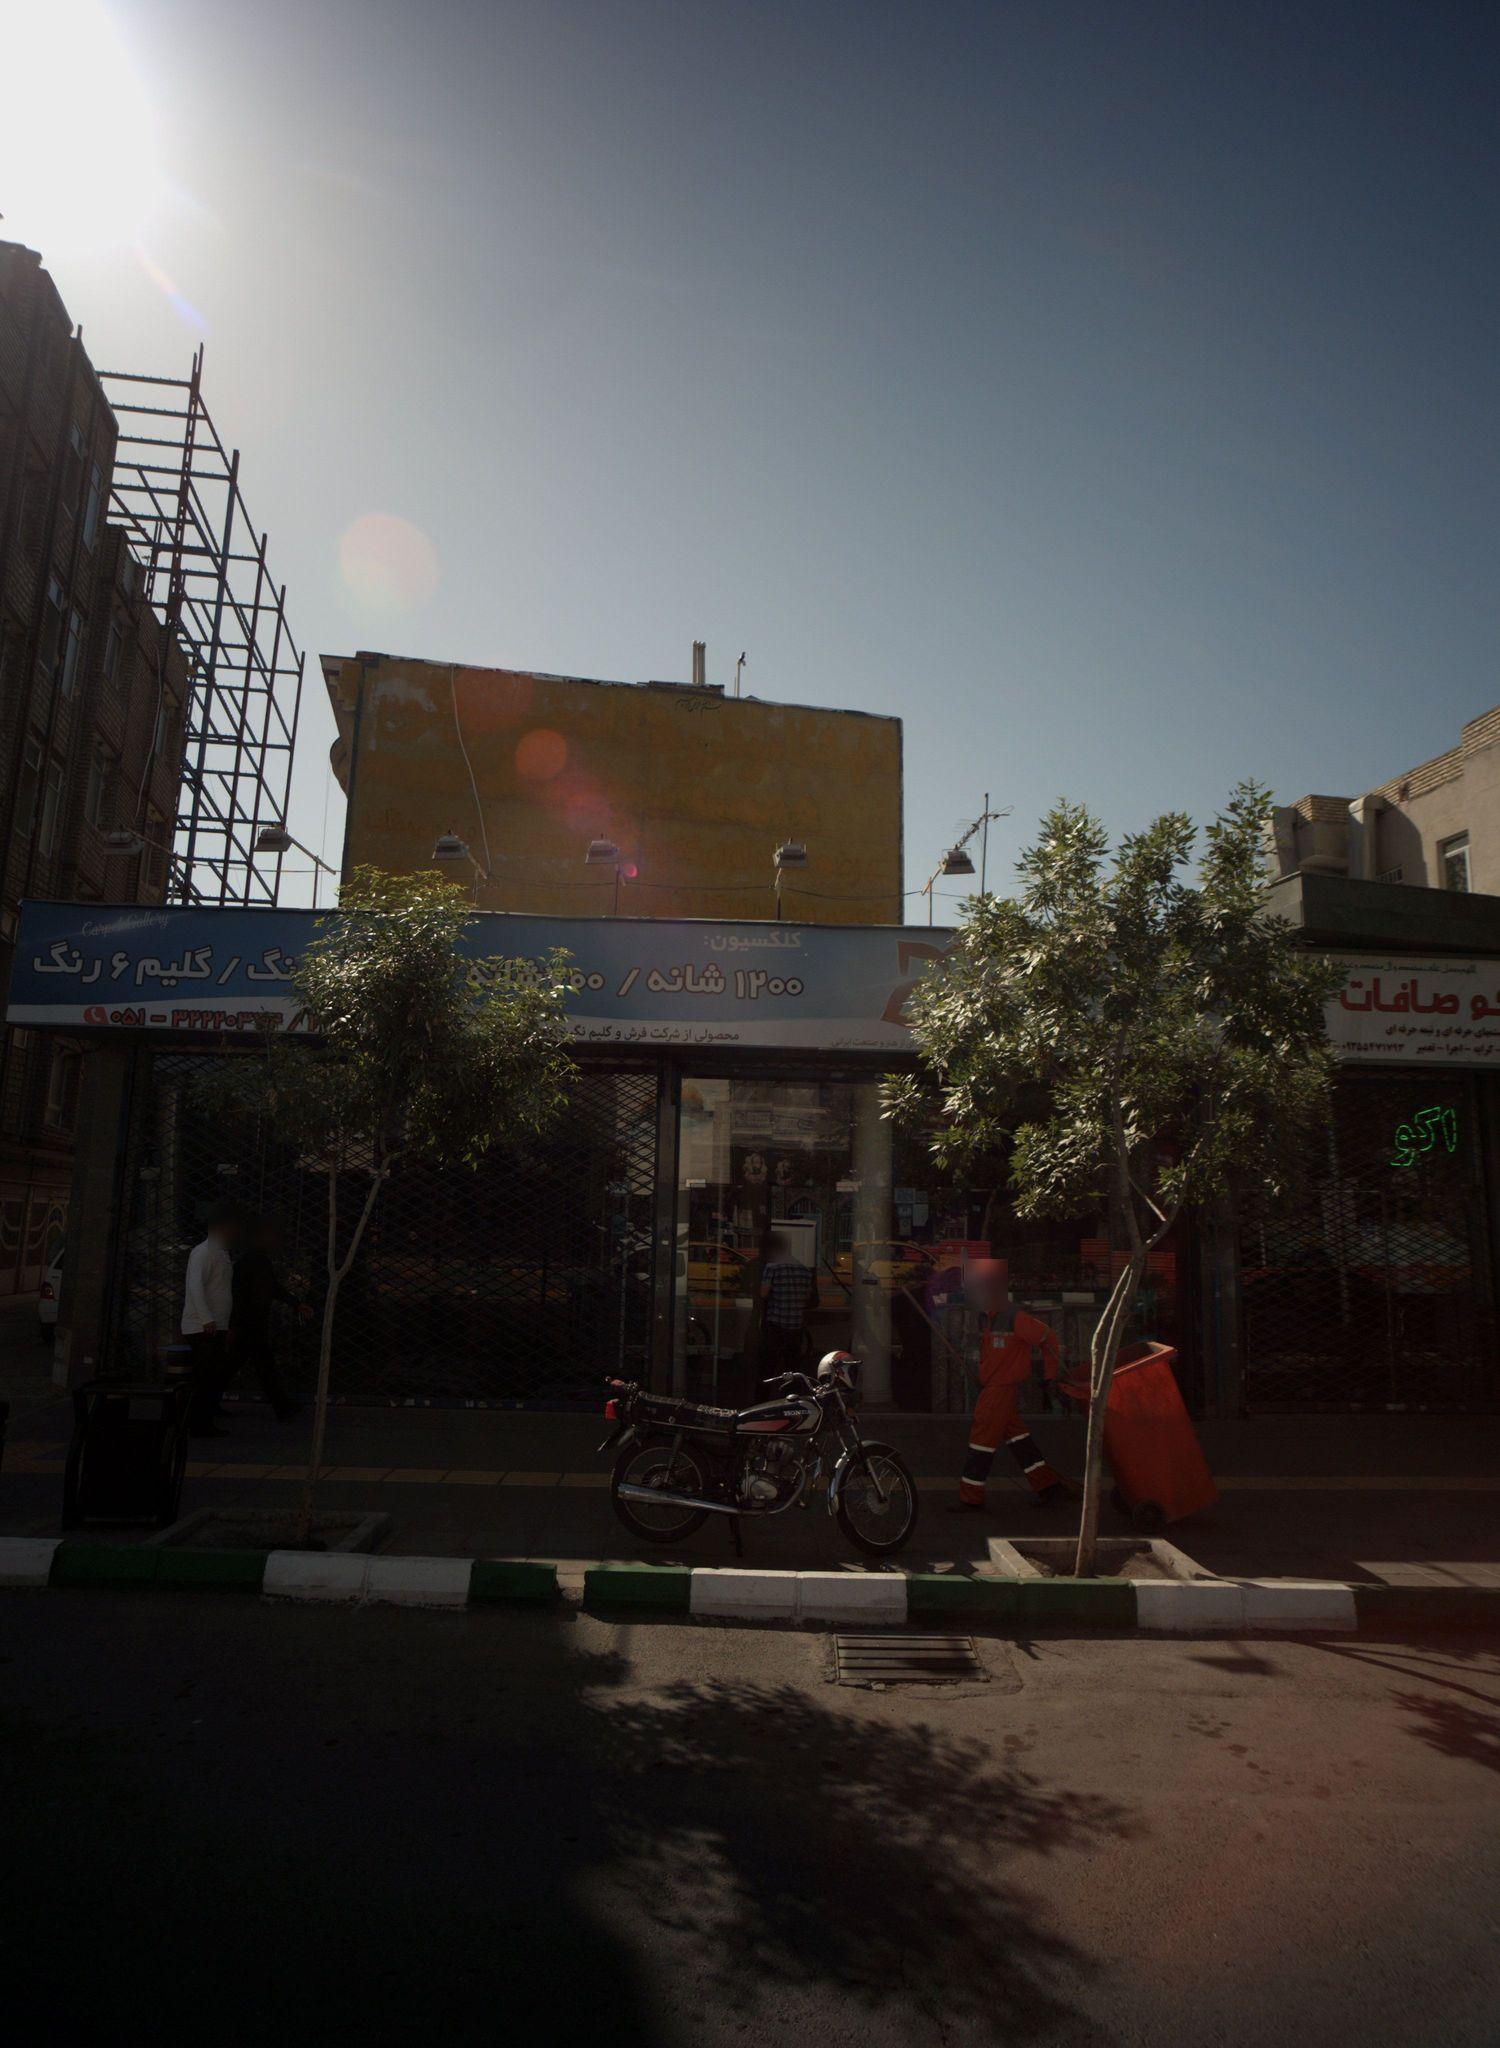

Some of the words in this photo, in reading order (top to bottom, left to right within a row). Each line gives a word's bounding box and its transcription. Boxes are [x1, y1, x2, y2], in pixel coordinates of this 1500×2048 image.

[705, 931, 802, 952] کلکسیون:
[33, 941, 103, 984] رنگ
[110, 952, 131, 981] ۶
[135, 946, 213, 986] گلیم
[647, 962, 726, 996] شانه
[735, 969, 805, 999] ۱۲۰۰
[1340, 977, 1459, 1015] صافات
[110, 1007, 145, 1026] ۰۵۱
[589, 1024, 613, 1041] گلیم
[615, 1029, 622, 1040] و
[624, 1026, 647, 1041] فرش
[650, 1027, 680, 1041] شرکت
[682, 1029, 692, 1042] از
[695, 1028, 740, 1043] محصولی
[1388, 1106, 1457, 1167] اکو
